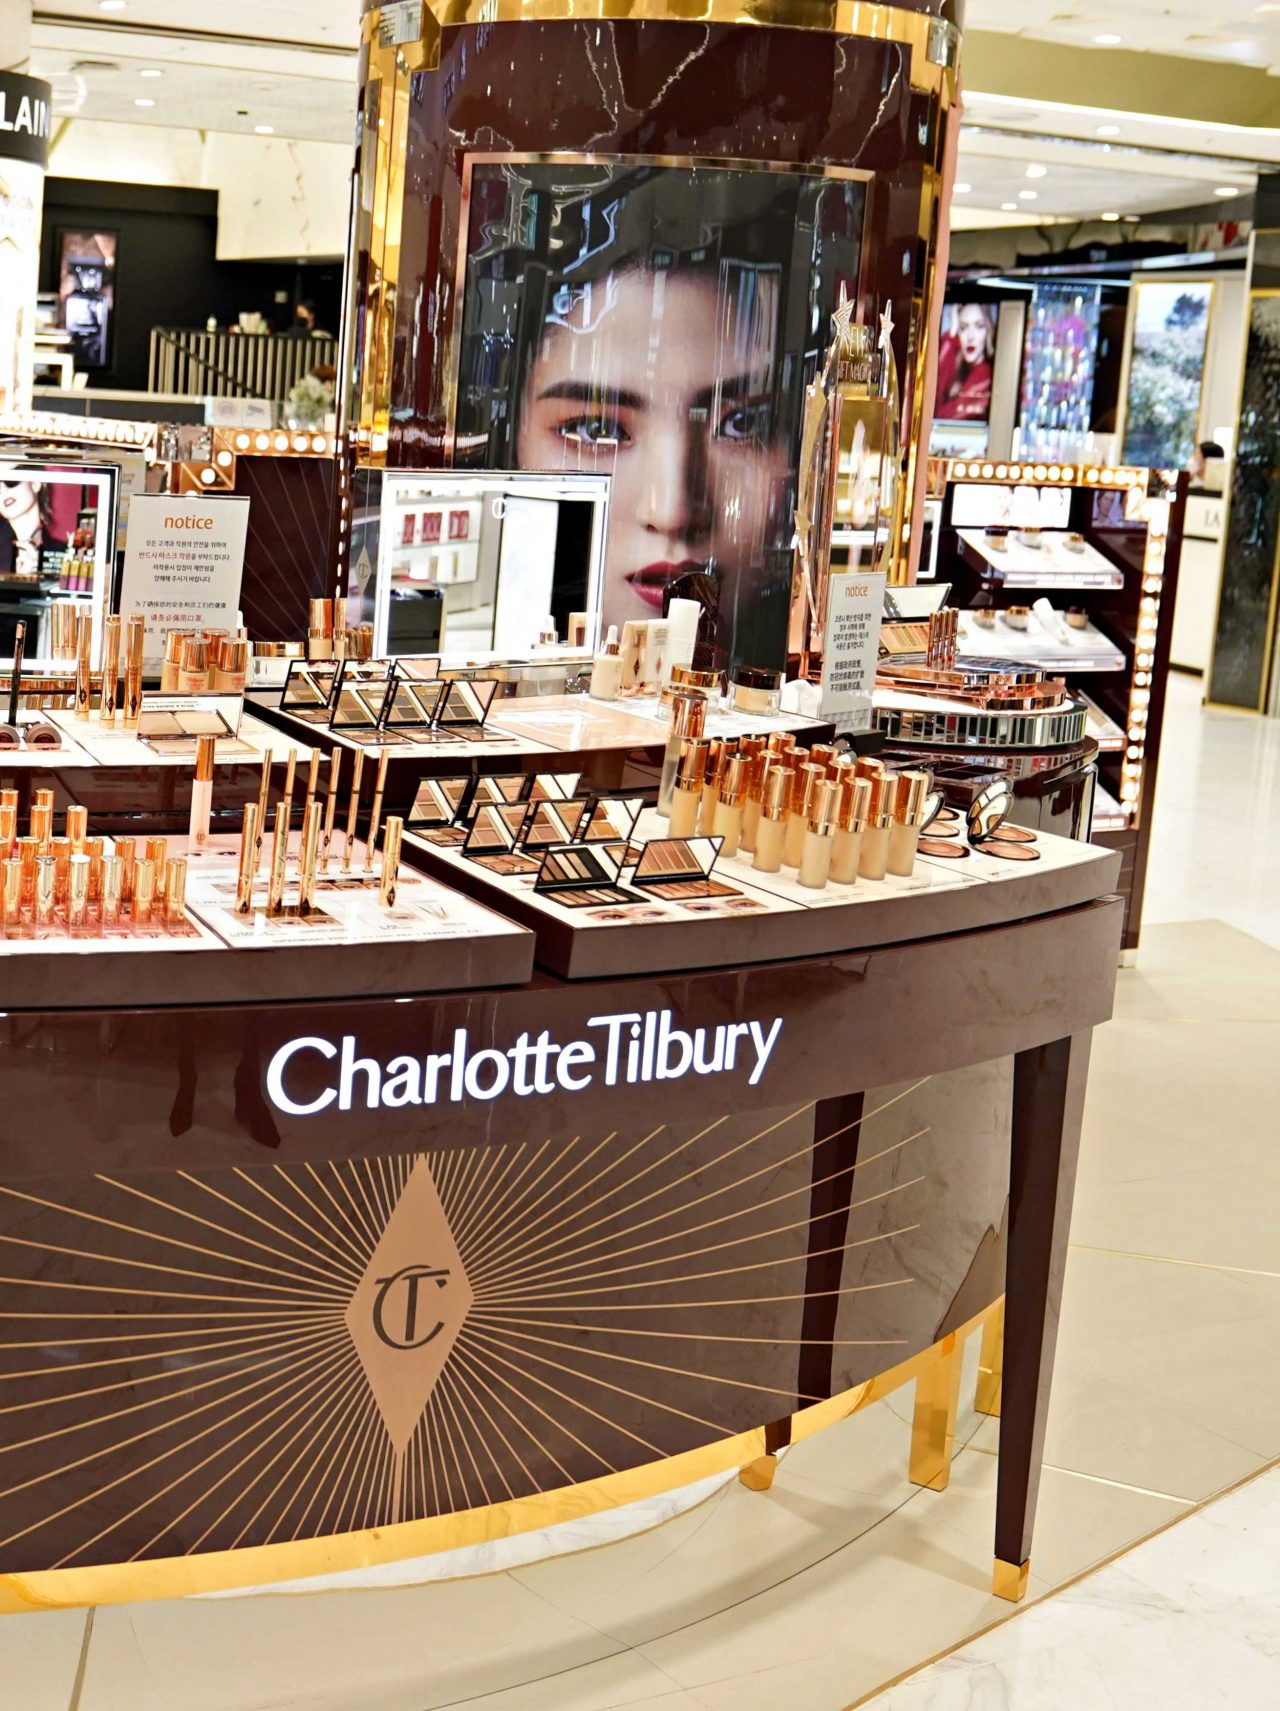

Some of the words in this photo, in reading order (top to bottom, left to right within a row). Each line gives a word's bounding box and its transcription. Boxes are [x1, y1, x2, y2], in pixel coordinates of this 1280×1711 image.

[164, 514, 214, 530] notice
[138, 551, 158, 559] 반드시
[158, 552, 178, 560] 마스크
[845, 584, 869, 598] notice
